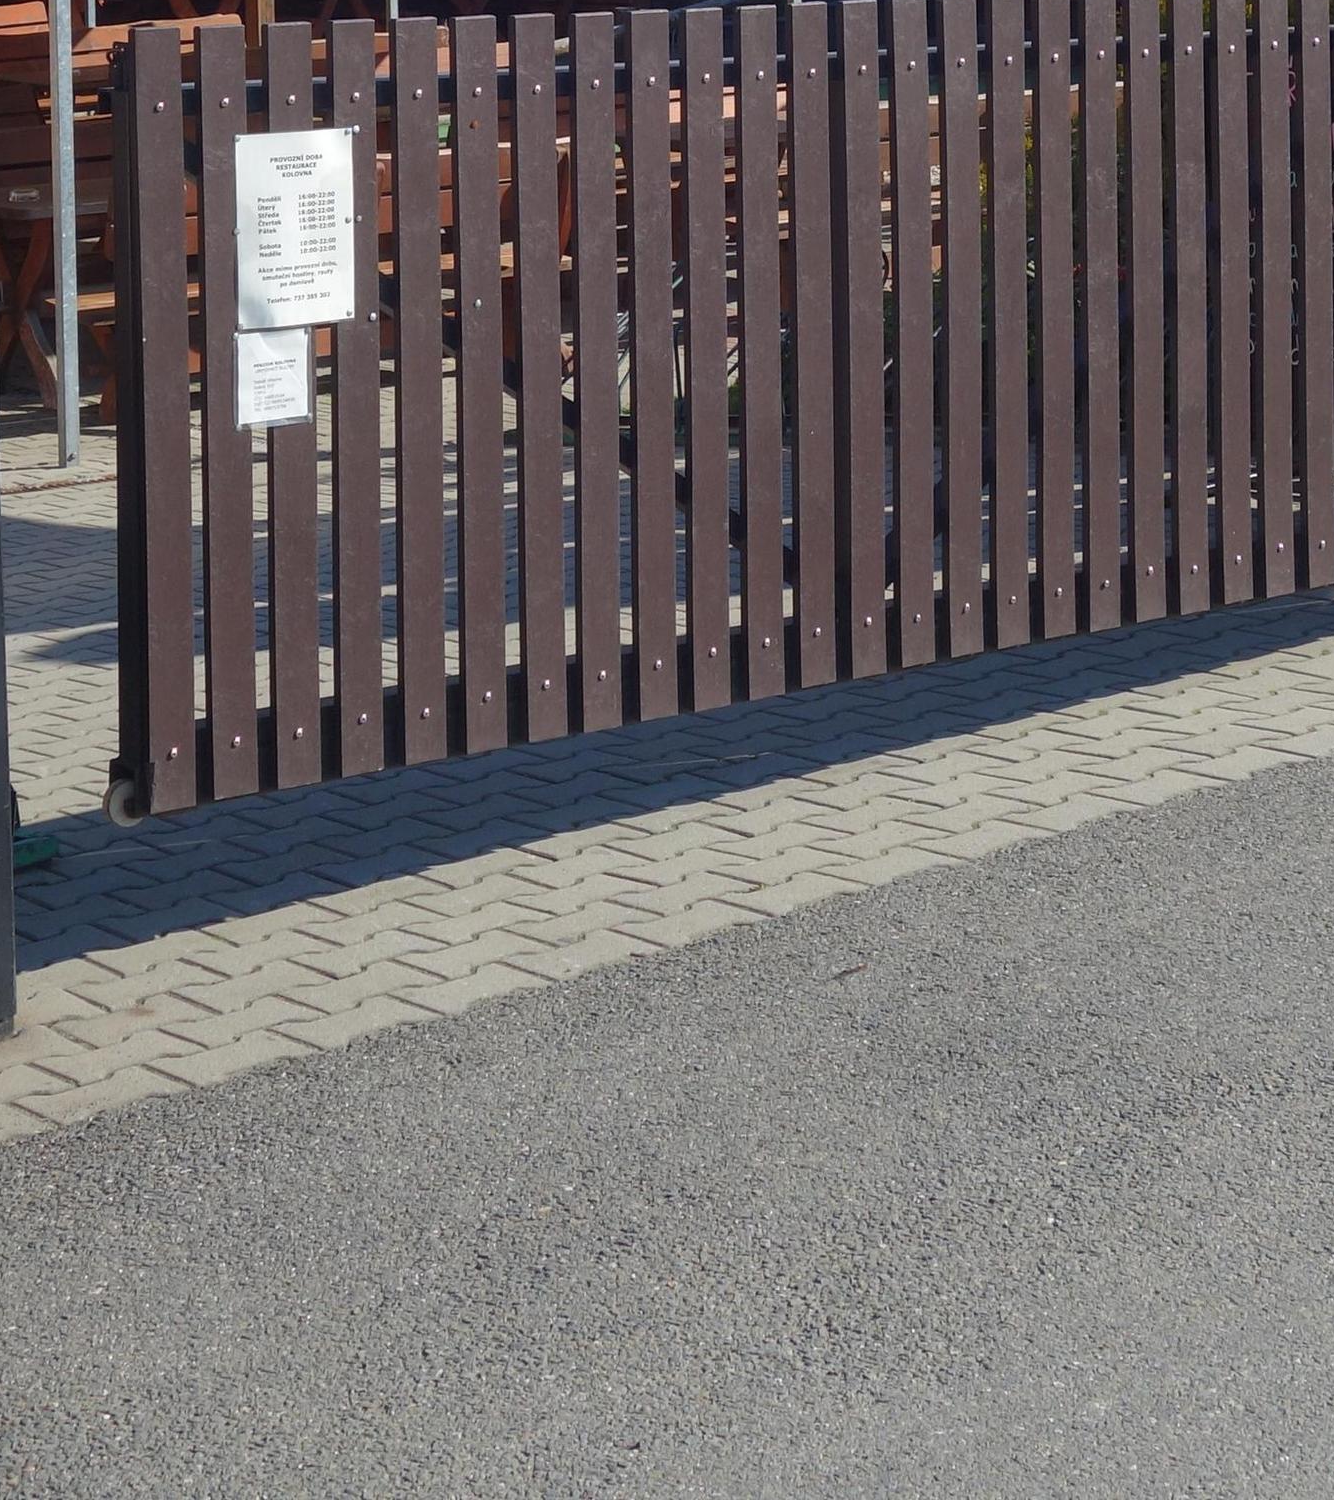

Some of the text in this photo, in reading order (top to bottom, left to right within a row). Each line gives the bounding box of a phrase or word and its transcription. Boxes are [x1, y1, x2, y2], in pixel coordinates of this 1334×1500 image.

[270, 154, 304, 163] PROVOZNÍ
[276, 161, 317, 171] RESTAURACE
[282, 170, 313, 178] KOLOVNA
